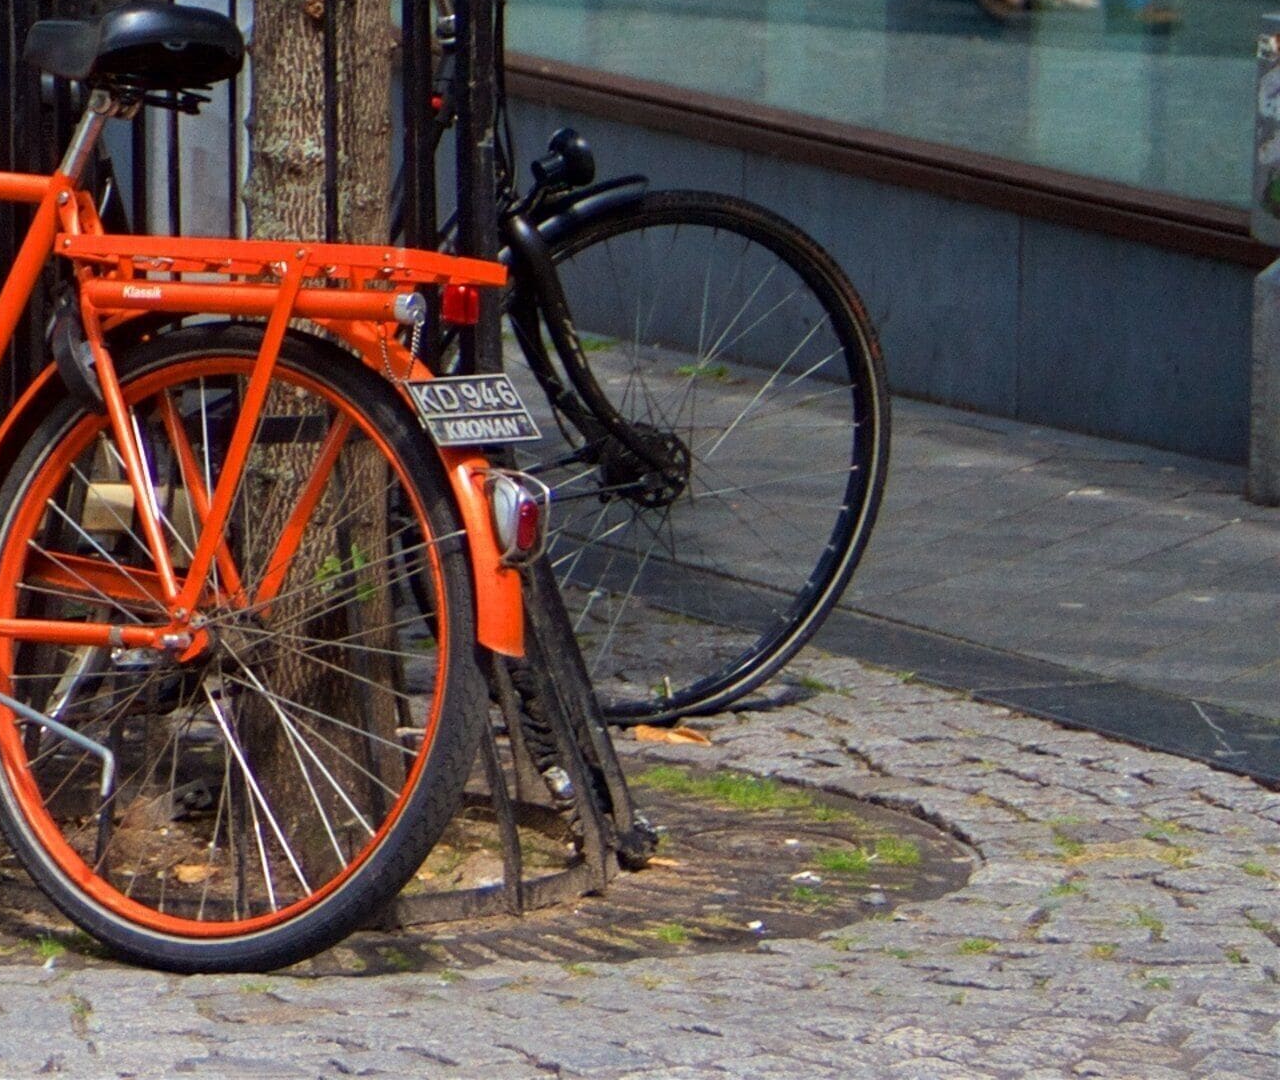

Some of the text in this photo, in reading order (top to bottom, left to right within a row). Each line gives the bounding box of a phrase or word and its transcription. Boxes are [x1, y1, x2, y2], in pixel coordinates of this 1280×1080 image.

[412, 380, 518, 412] KD 946
[445, 416, 521, 440] KRONAN
